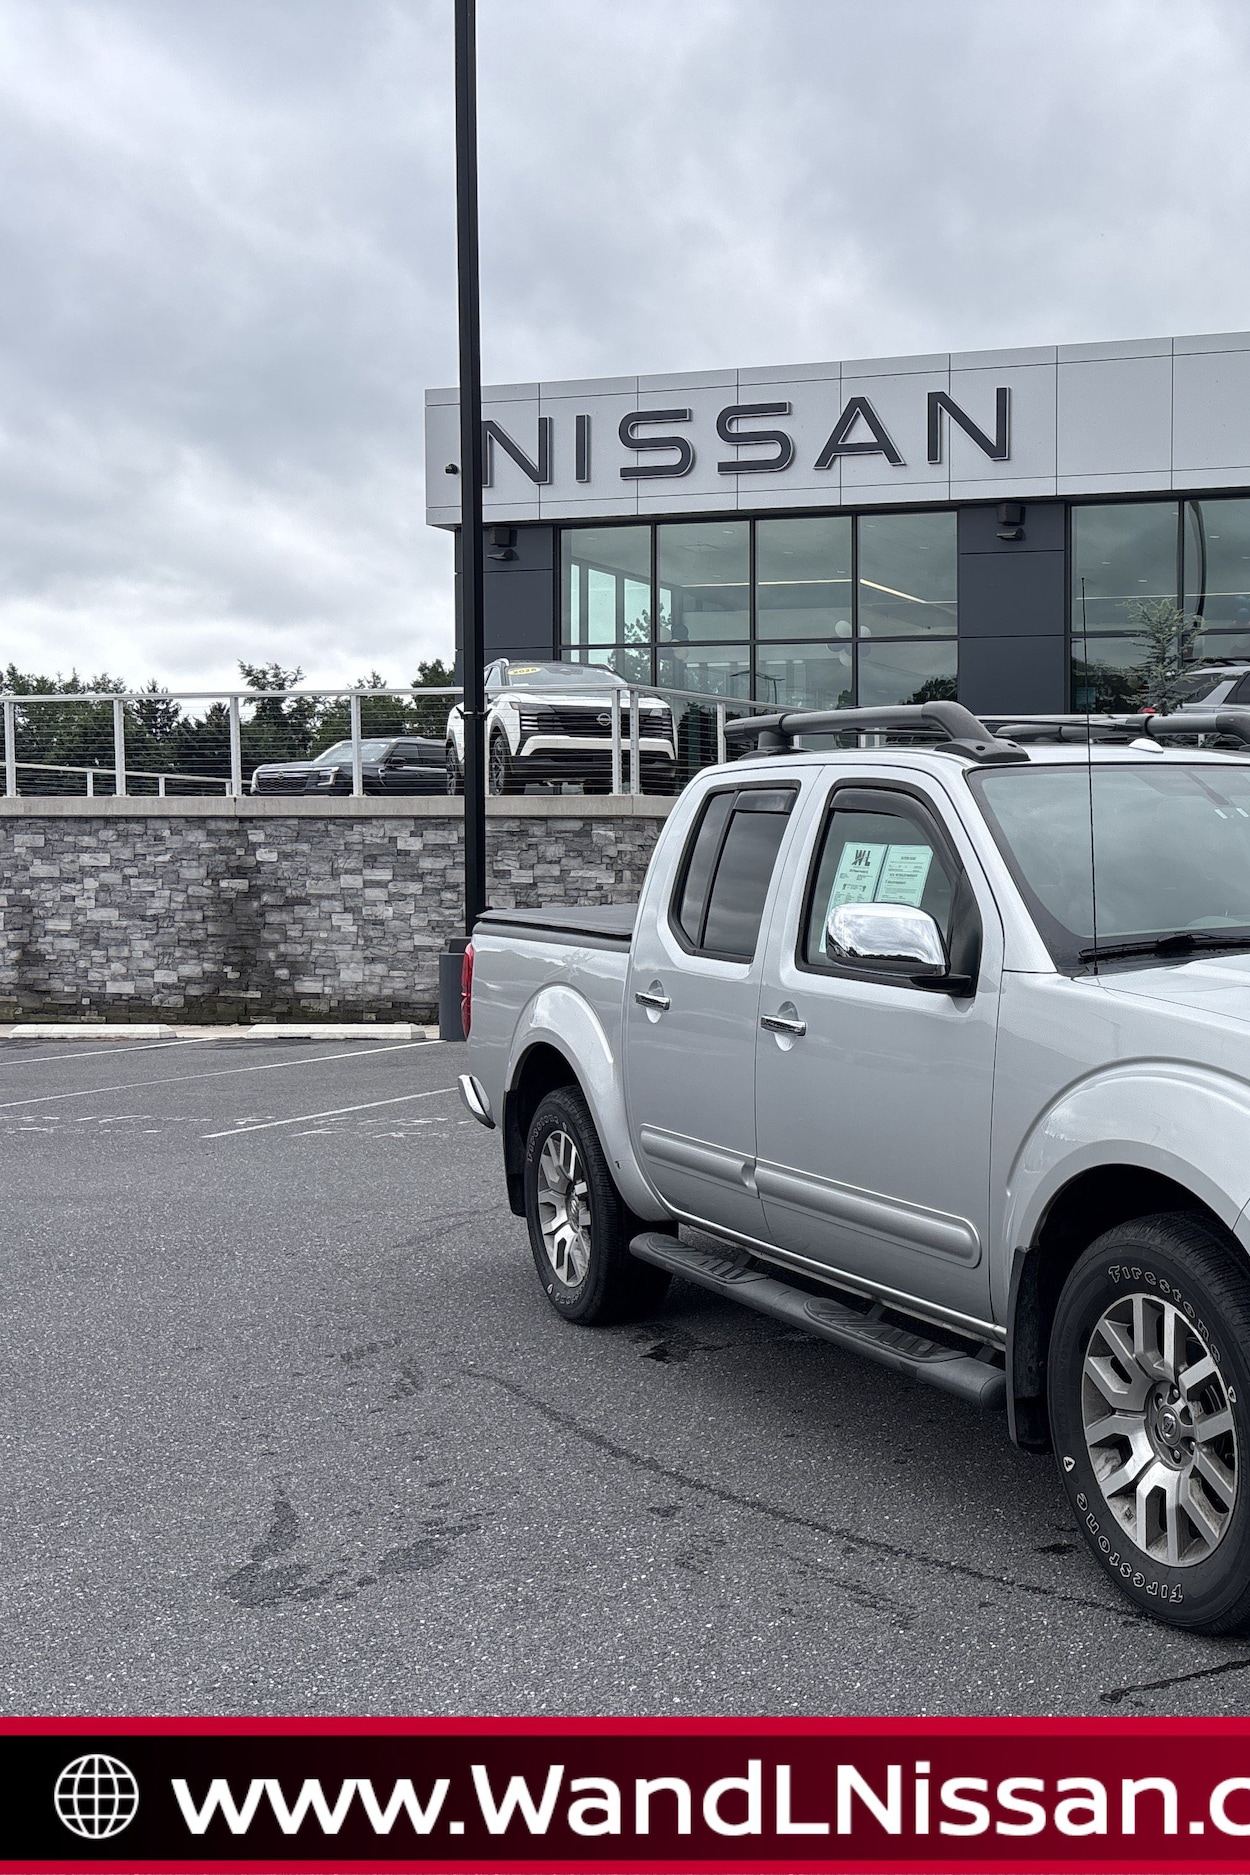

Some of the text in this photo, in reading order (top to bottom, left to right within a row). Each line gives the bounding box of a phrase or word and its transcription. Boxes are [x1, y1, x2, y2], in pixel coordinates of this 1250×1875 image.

[481, 386, 1011, 487] NISSAN
[1108, 1264, 1221, 1364] Firestone
[1076, 1492, 1184, 1604] Firestone
